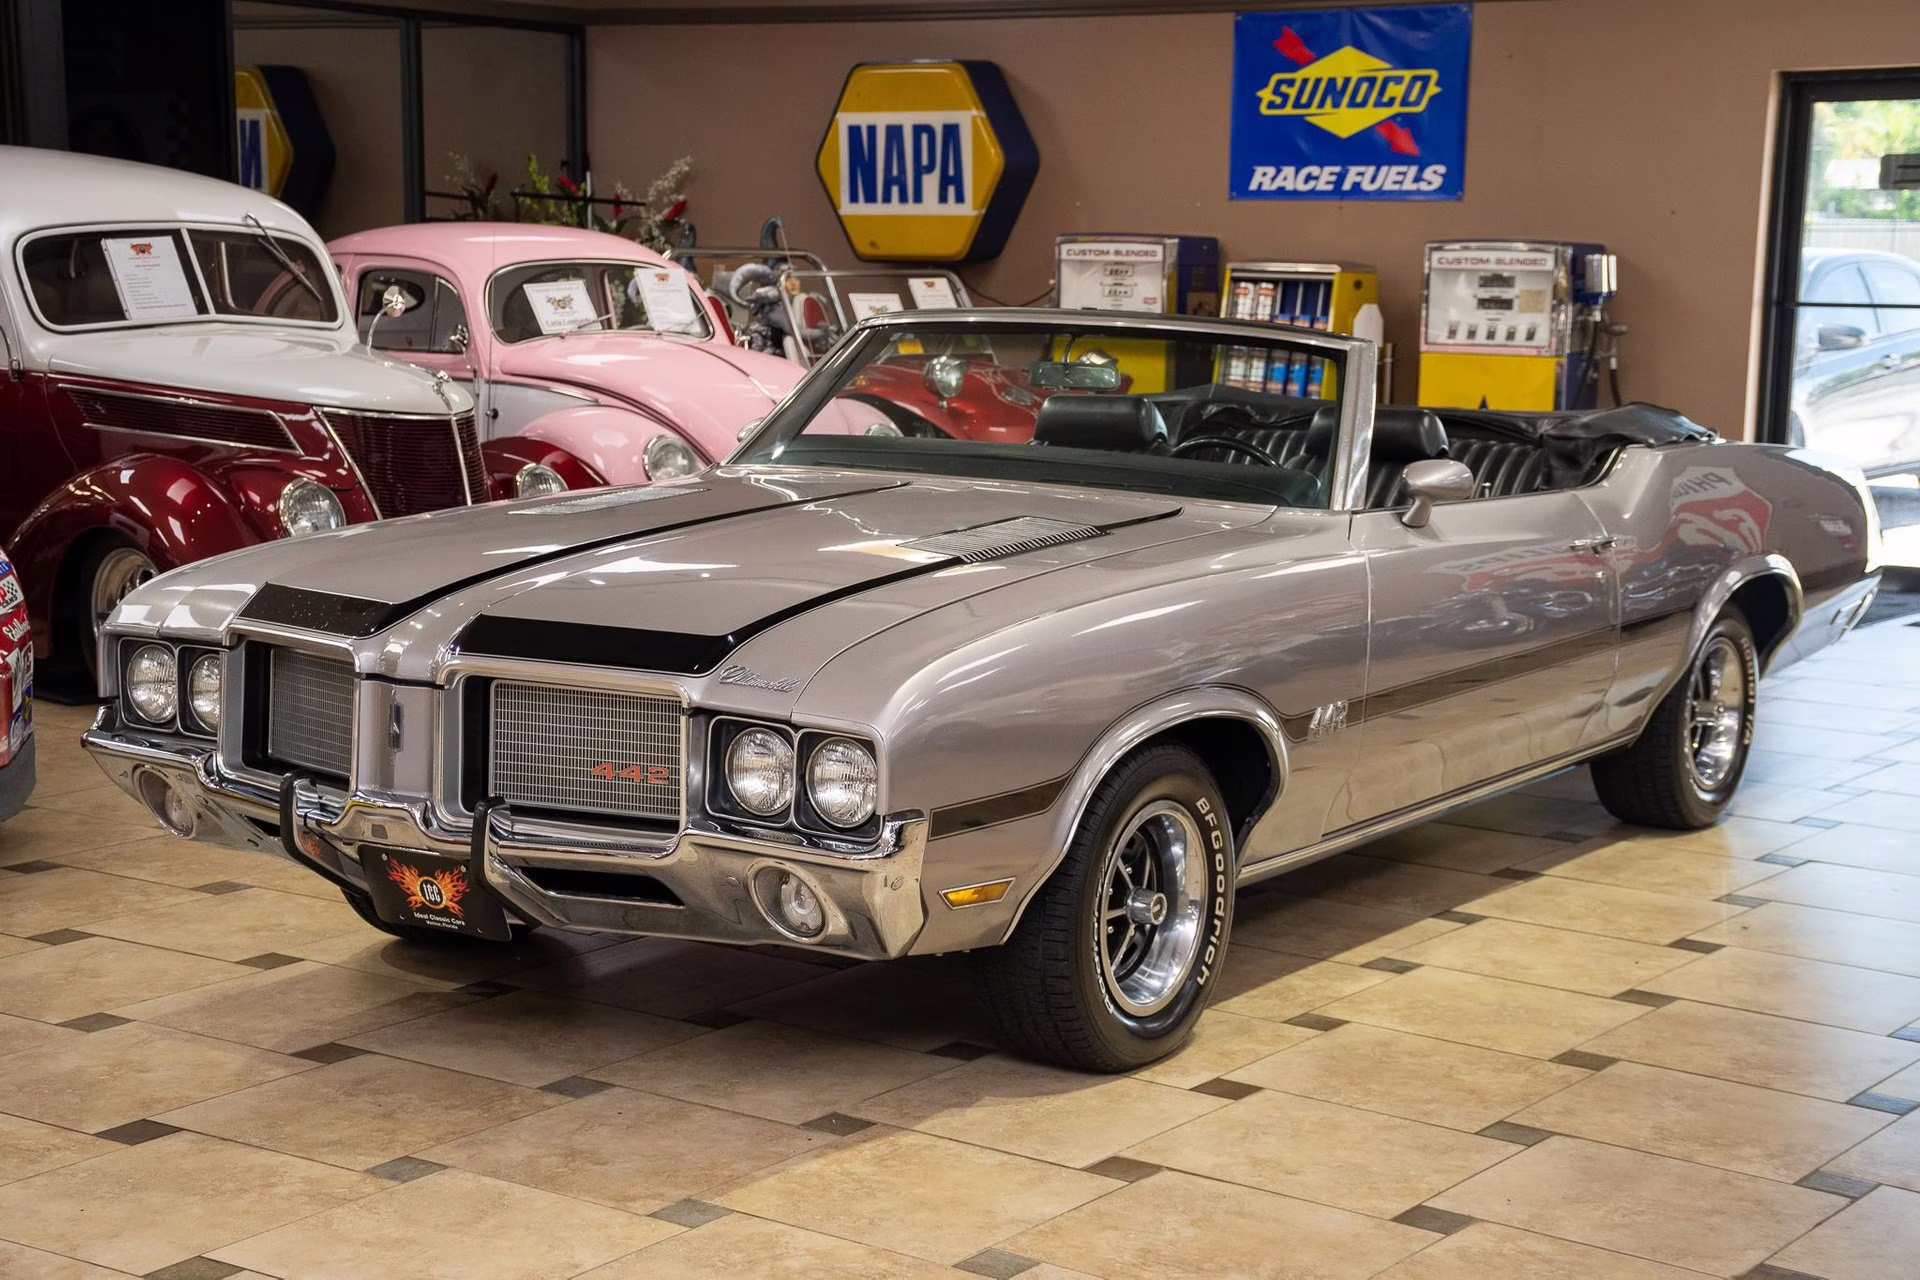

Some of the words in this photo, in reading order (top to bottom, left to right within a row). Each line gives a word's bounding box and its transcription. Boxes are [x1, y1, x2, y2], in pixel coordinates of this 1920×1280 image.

[1265, 74, 1432, 110] SUNOCO
[847, 123, 965, 204] NAPA
[1248, 165, 1342, 191] RACE
[1341, 164, 1447, 191] FUELS
[591, 762, 670, 784] 442
[422, 883, 441, 903] ICC
[429, 914, 451, 923] Classic
